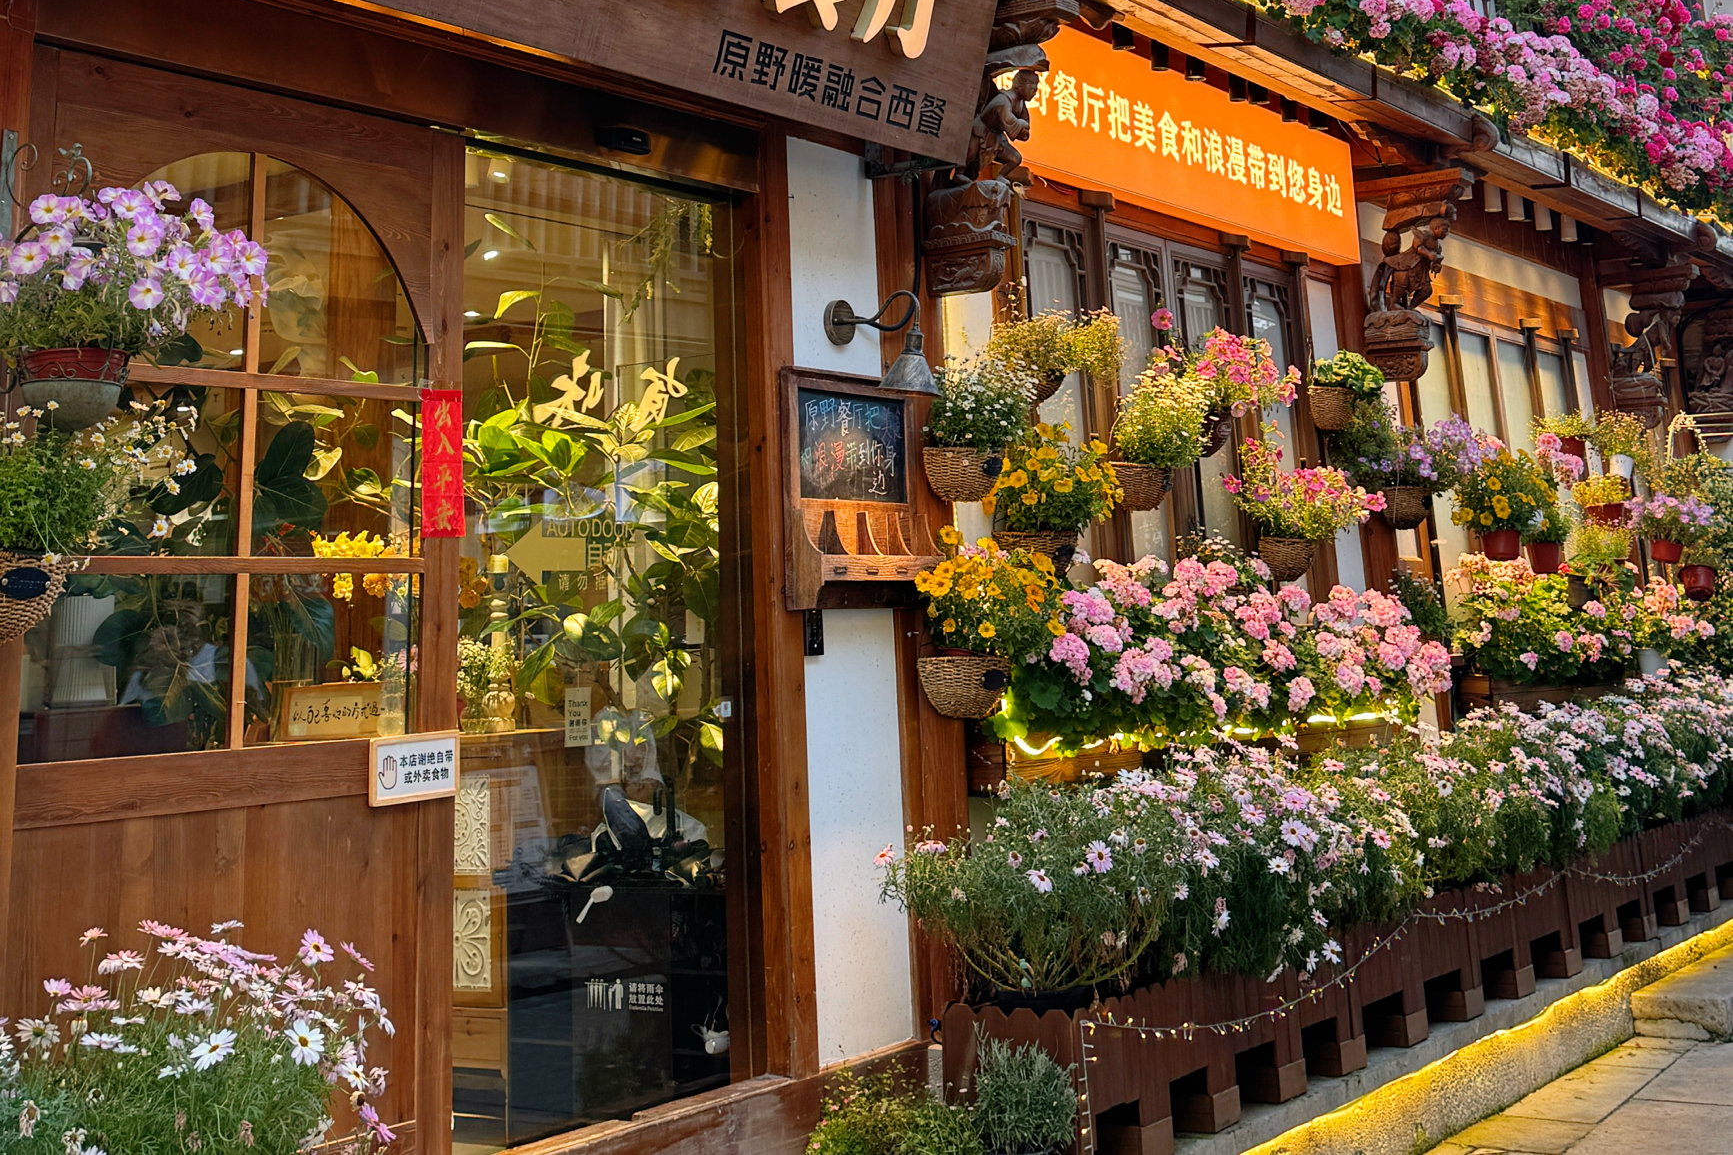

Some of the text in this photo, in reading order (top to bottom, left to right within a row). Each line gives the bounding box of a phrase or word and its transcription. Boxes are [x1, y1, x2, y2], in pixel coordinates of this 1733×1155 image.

[712, 29, 947, 139] 原野暖融合西餐
[430, 398, 456, 532] 出入平安
[399, 749, 453, 768] 本店谢绝自带
[403, 766, 449, 784] 或外卖食物
